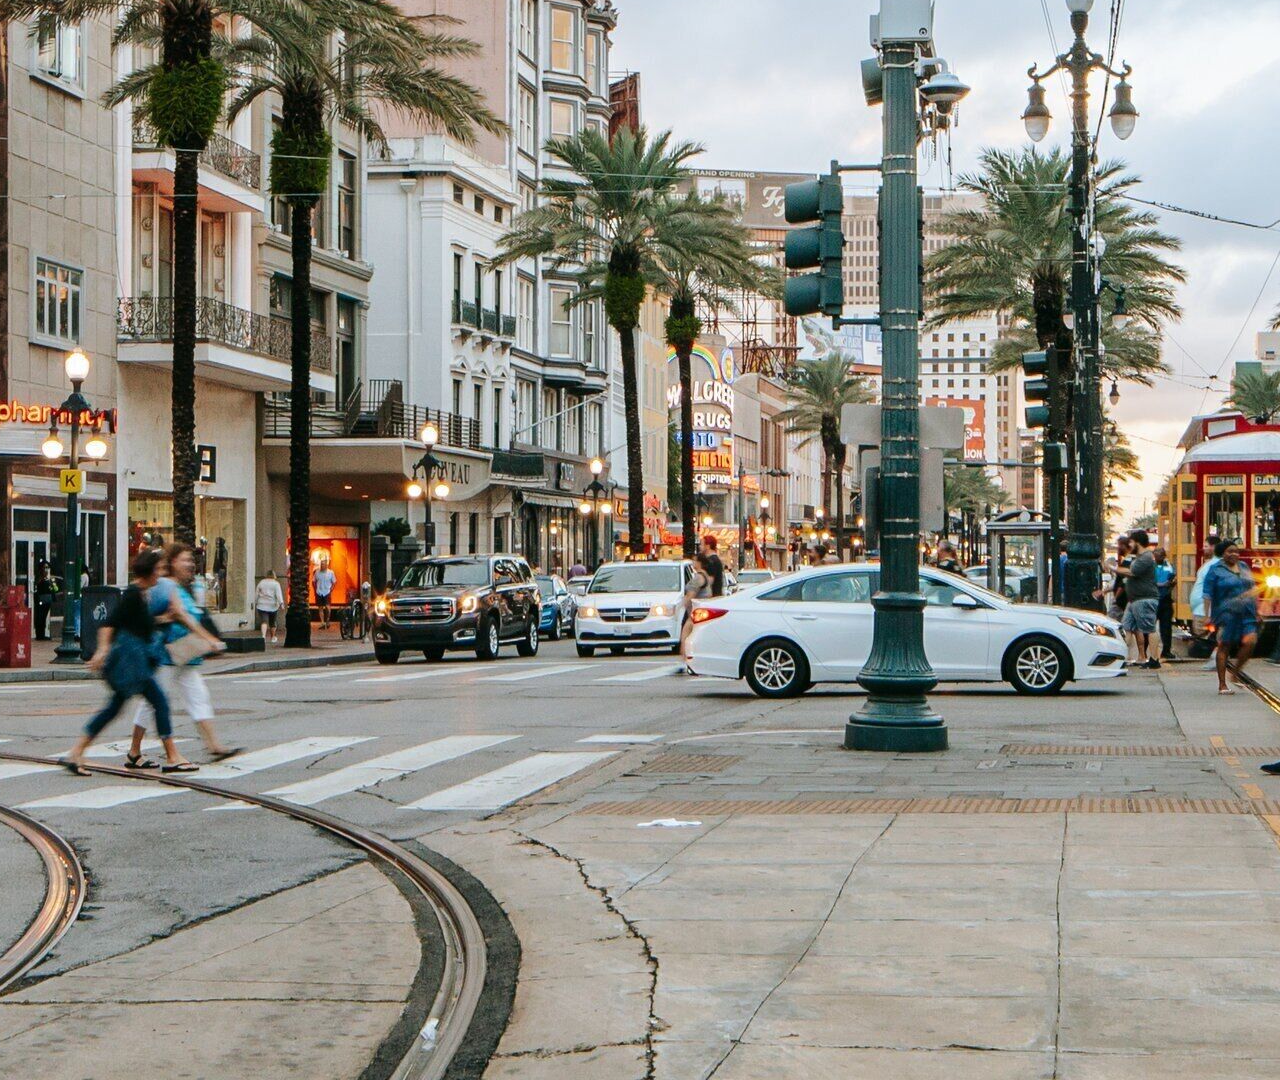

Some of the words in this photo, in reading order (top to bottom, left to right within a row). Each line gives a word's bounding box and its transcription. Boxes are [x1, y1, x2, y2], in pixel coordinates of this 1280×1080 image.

[688, 169, 718, 177] GRAND
[718, 170, 756, 179] OPENING
[693, 411, 732, 430] RUGS
[692, 451, 732, 469] SMETICS
[65, 474, 76, 488] K
